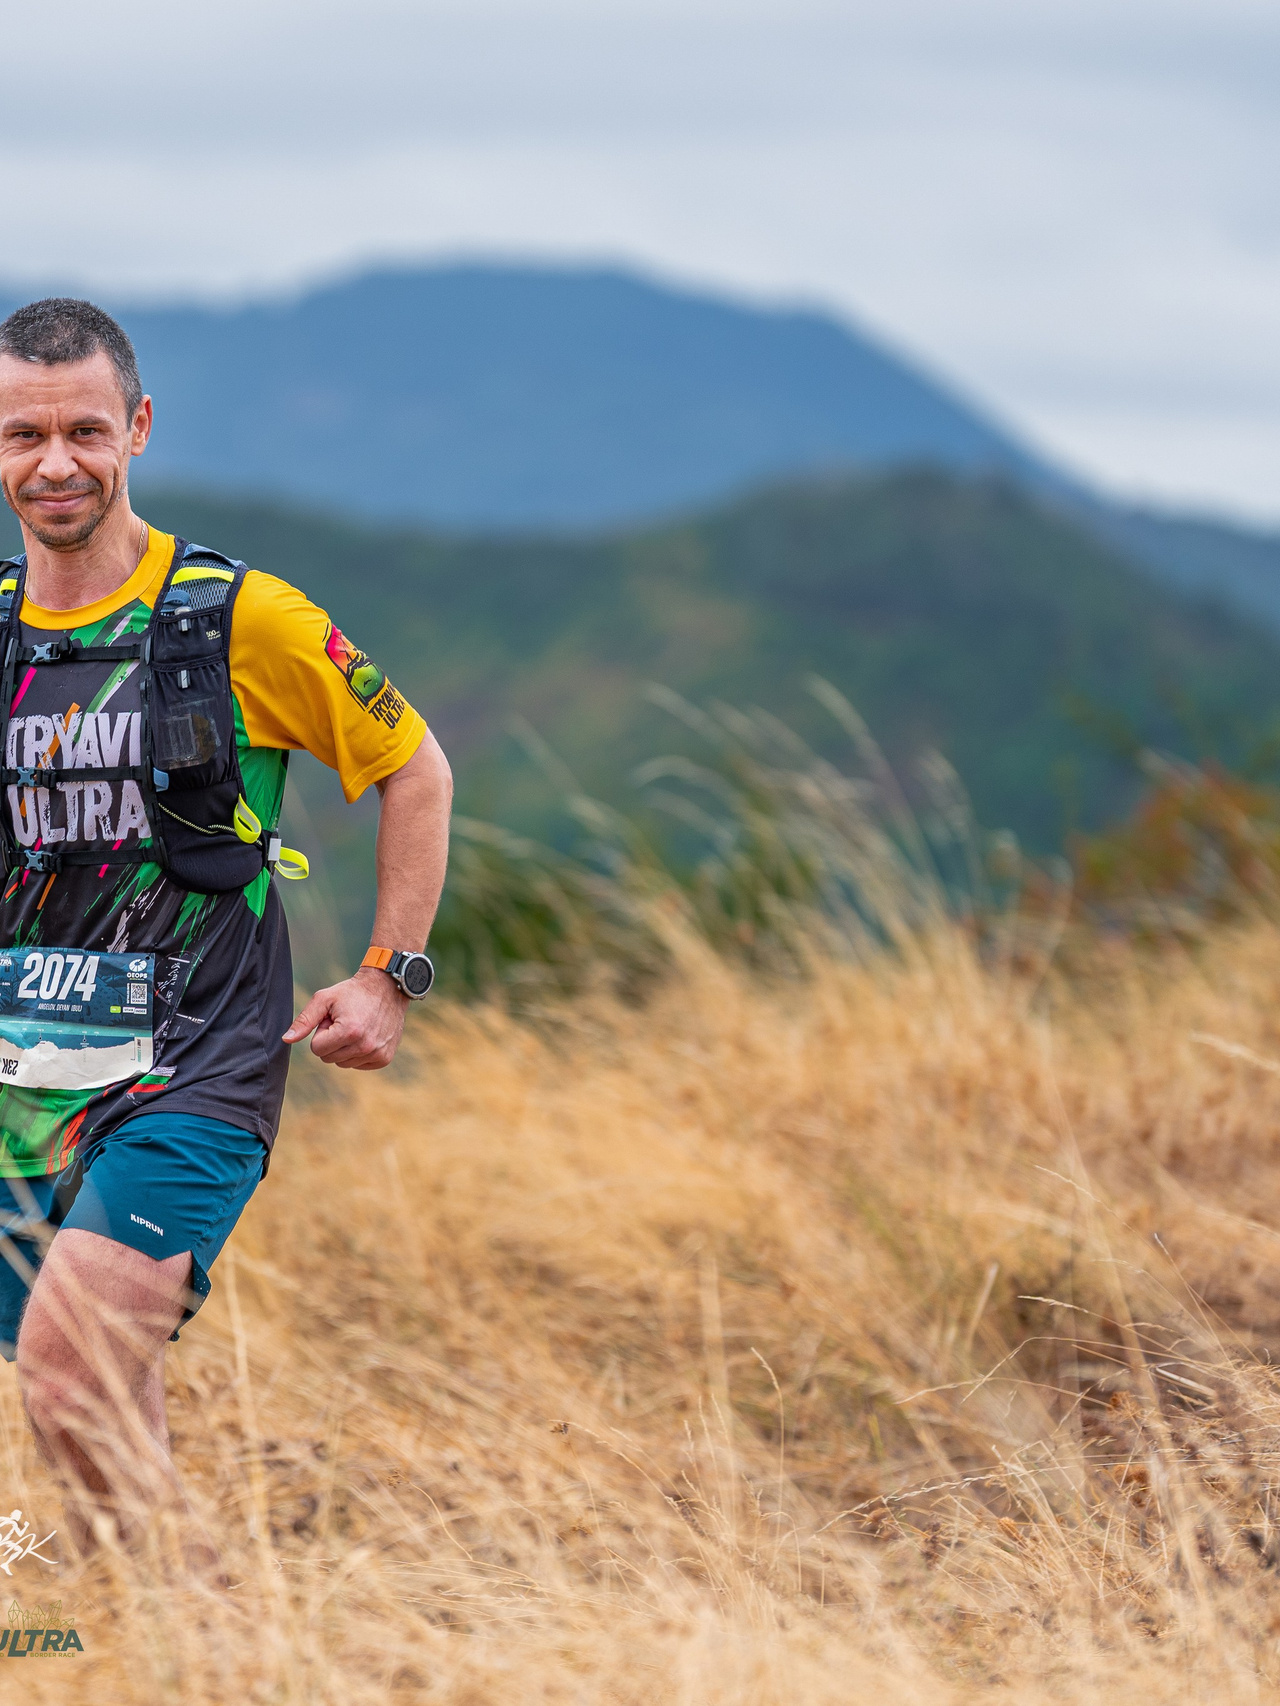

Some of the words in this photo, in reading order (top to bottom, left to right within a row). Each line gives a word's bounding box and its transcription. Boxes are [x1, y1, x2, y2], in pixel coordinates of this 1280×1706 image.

[7, 779, 153, 847] ULTRA
[17, 952, 100, 1002] 2074
[1, 1058, 19, 1076] 23K
[130, 1213, 164, 1236] KIPRUN
